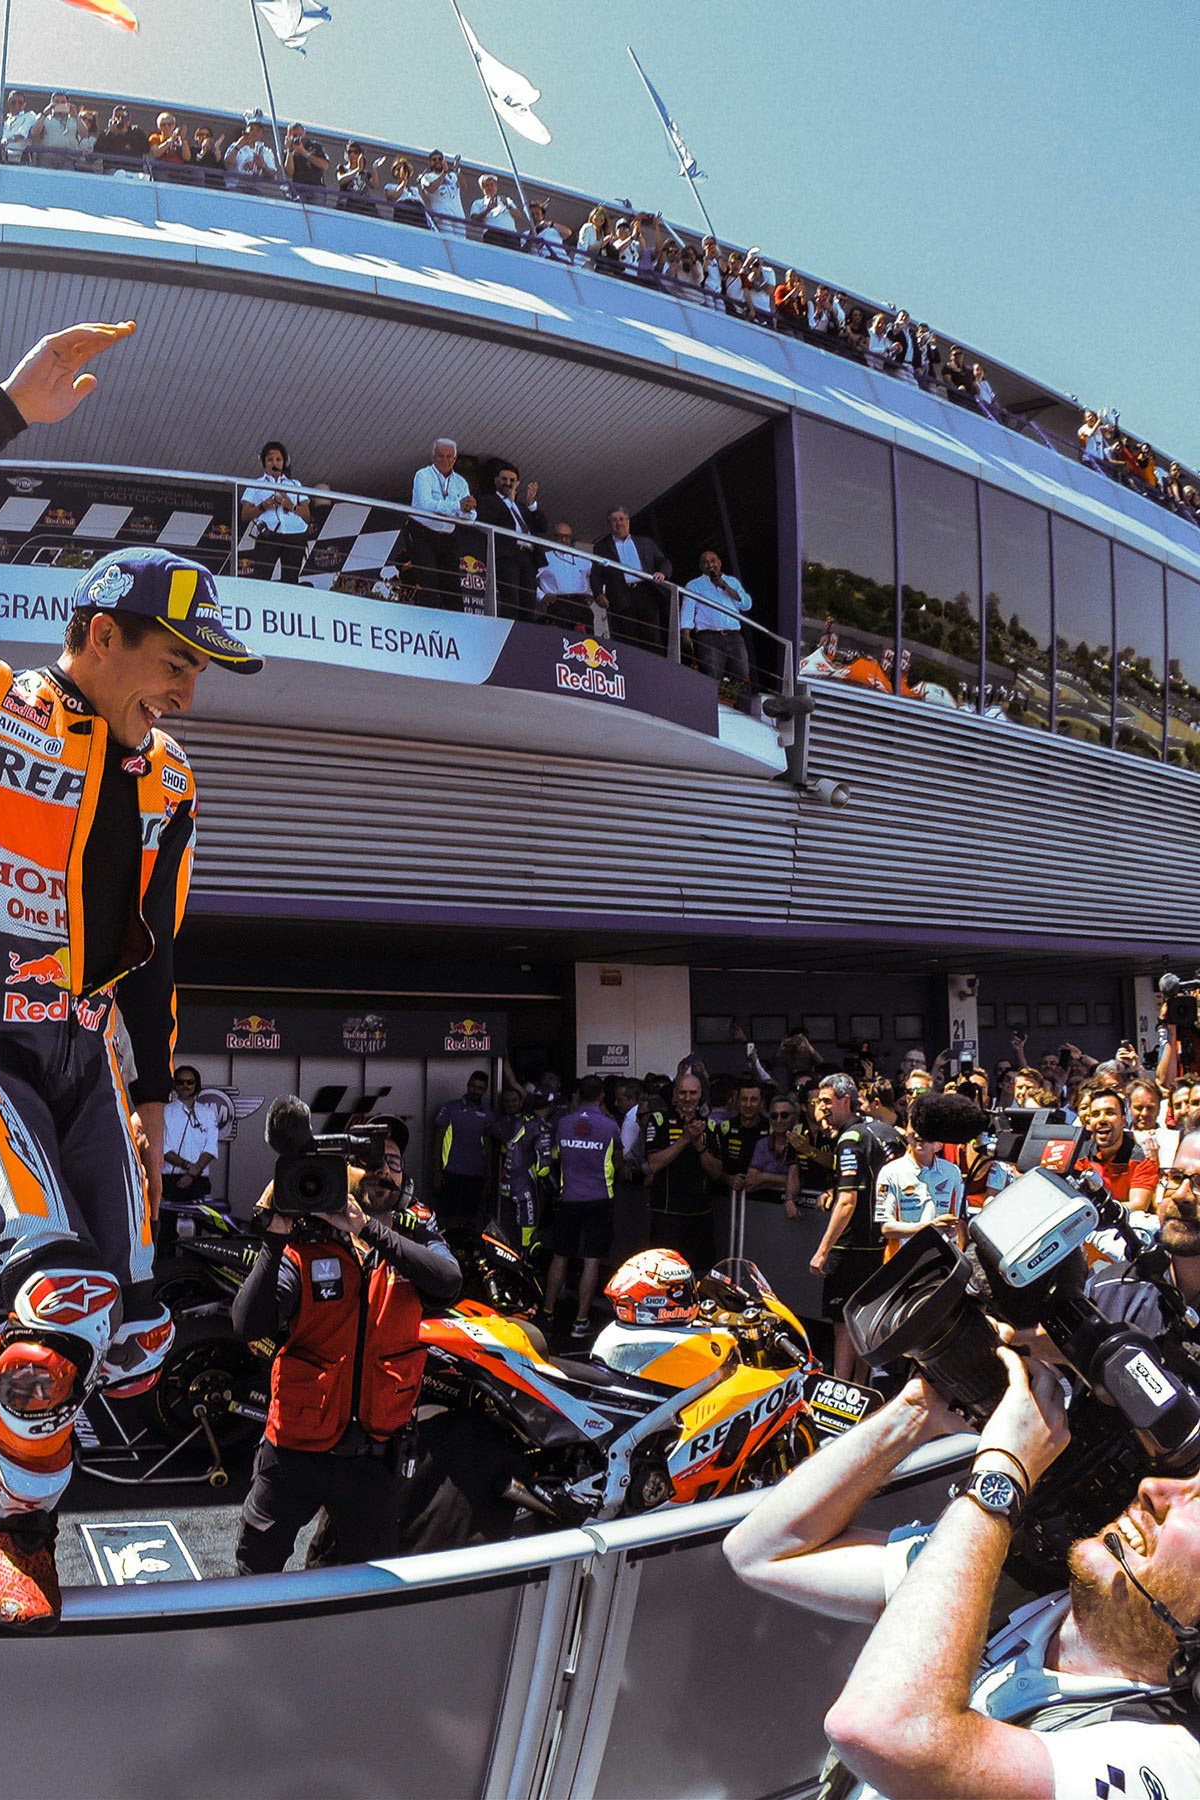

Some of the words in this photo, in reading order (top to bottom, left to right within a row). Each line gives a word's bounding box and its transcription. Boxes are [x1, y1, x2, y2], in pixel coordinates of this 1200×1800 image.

[221, 605, 252, 631] ED
[262, 608, 325, 641] BULL
[333, 619, 362, 647] DE
[370, 626, 460, 661] ESPAÑA
[556, 663, 594, 692] Red
[594, 670, 625, 700] Bull
[7, 897, 49, 926] One
[3, 991, 69, 1023] Red
[226, 1033, 253, 1049] Red
[254, 1033, 280, 1049] Bull
[952, 1019, 966, 1040] 21
[560, 1139, 604, 1151] SUZUKI
[817, 1394, 861, 1415] VICTORY
